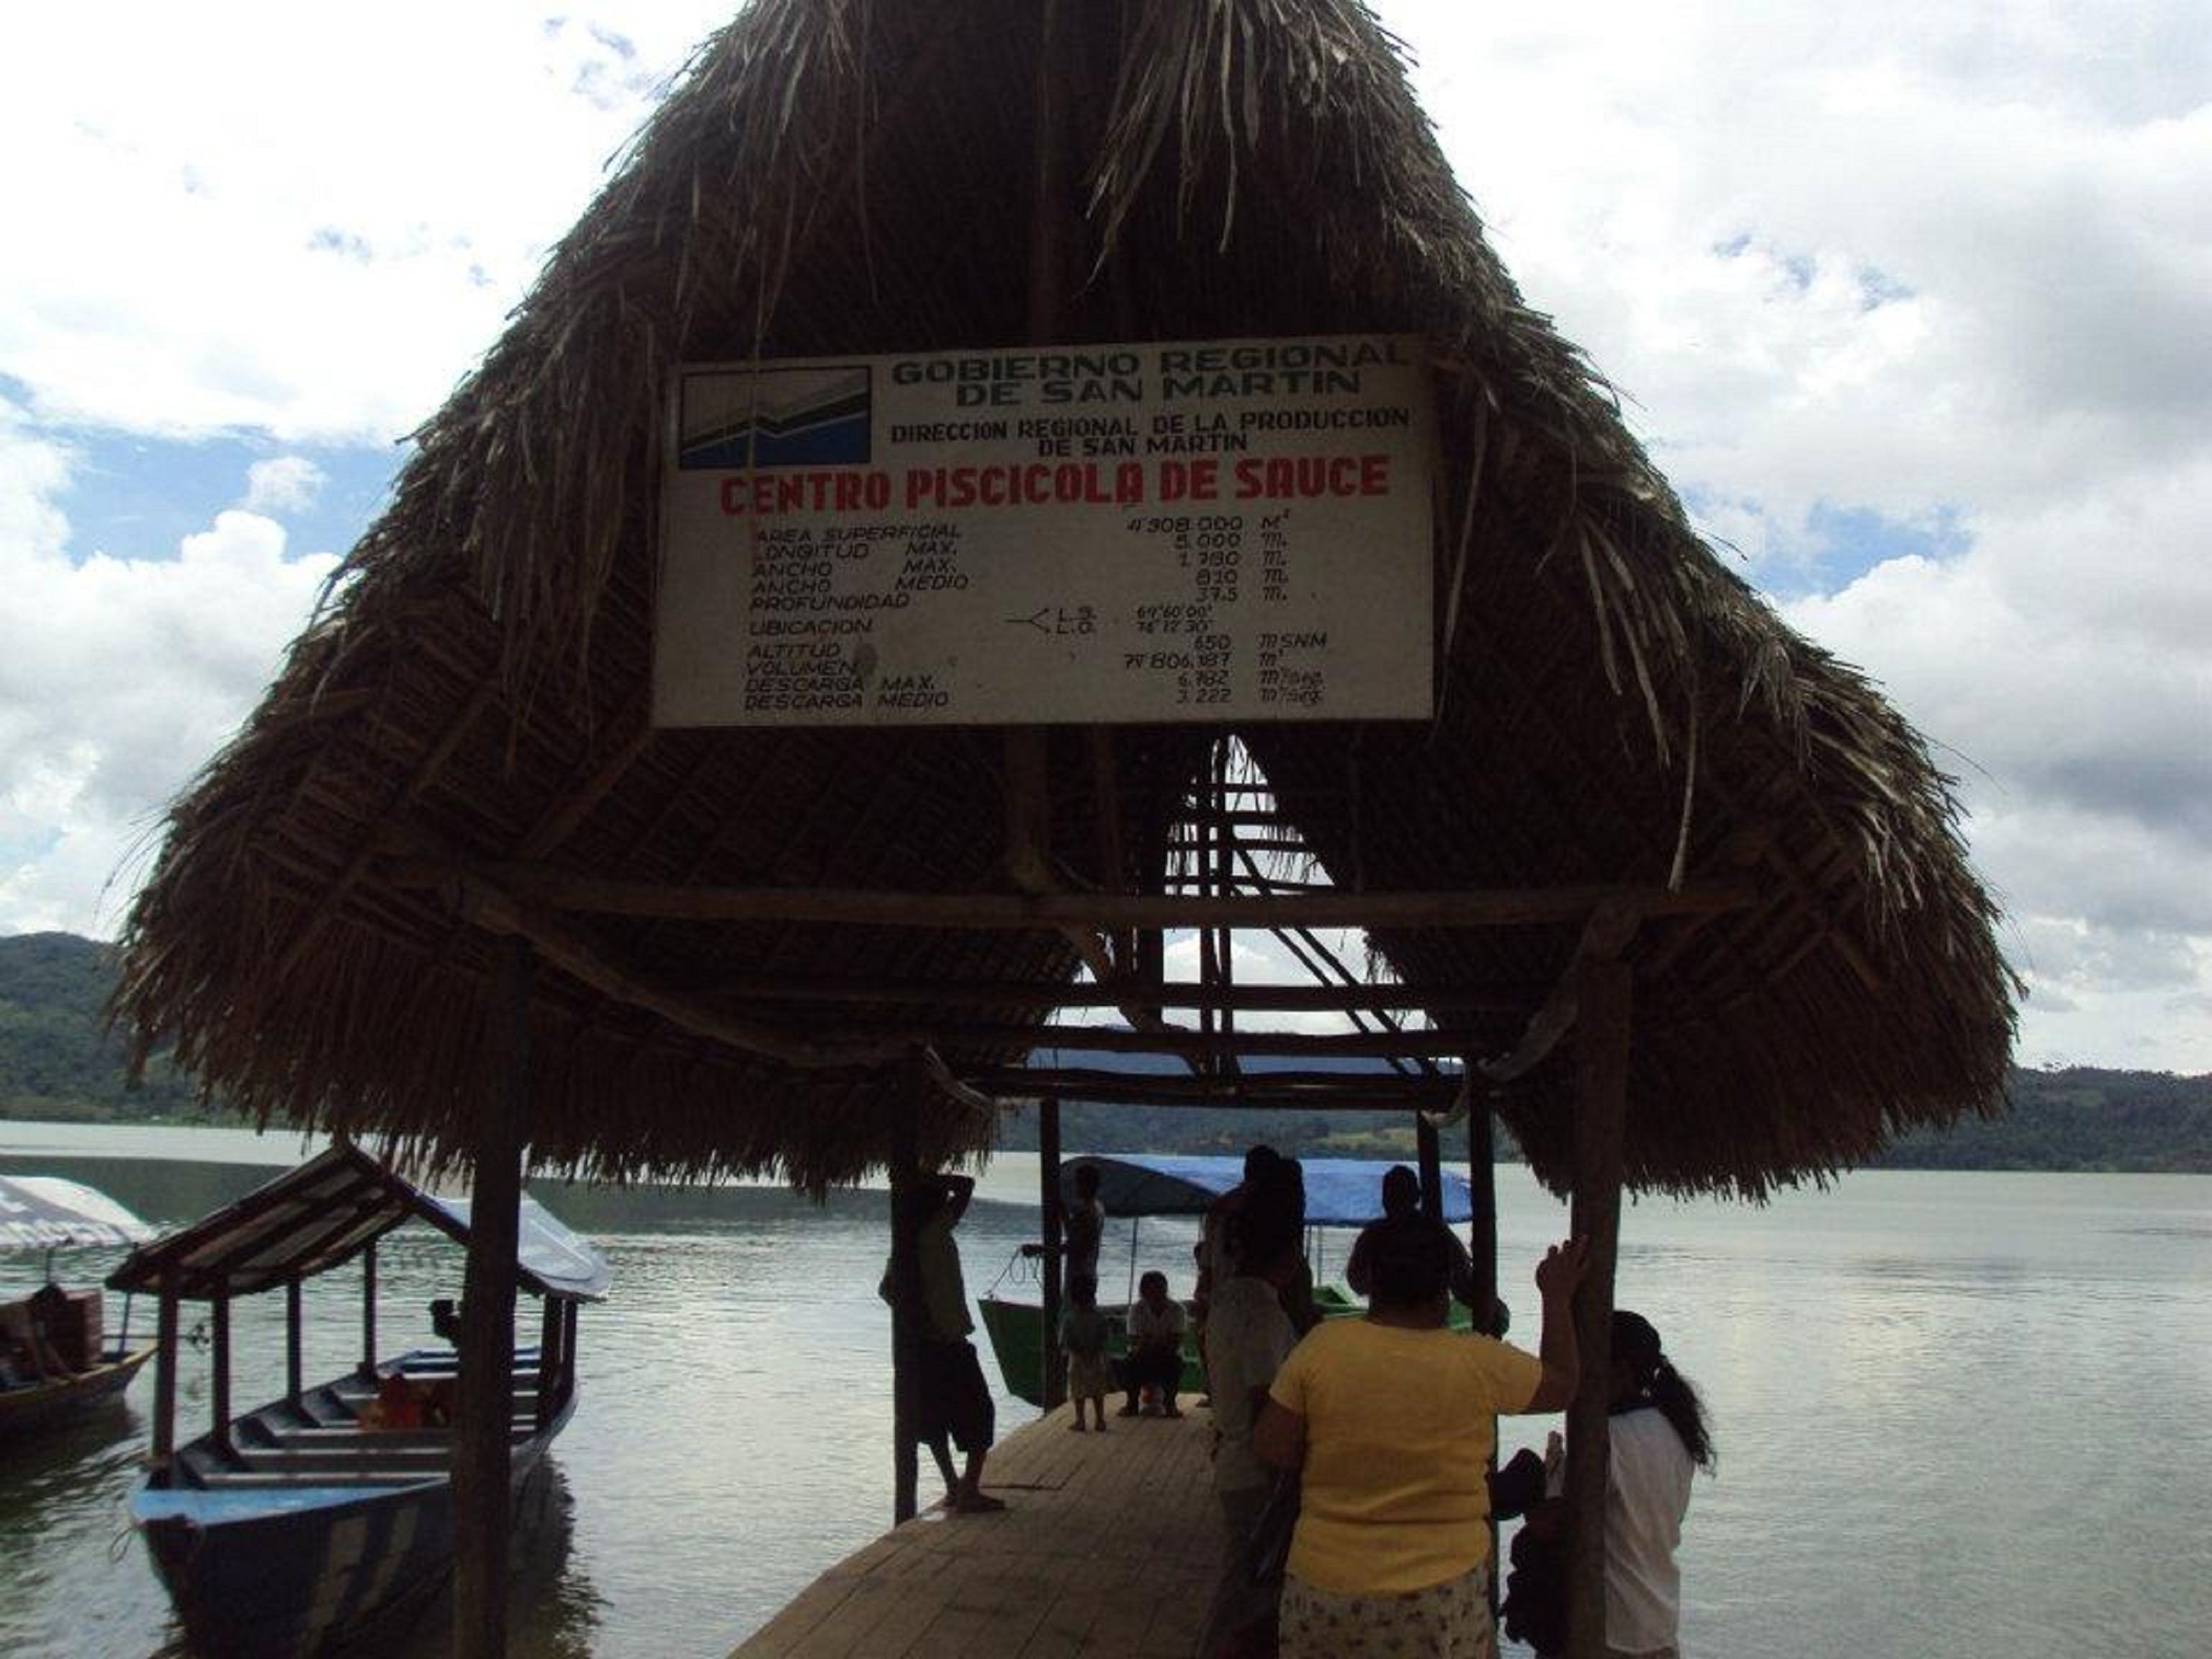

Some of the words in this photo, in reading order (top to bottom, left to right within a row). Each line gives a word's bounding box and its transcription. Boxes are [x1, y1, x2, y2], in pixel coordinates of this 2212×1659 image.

[891, 353, 1140, 385] GOBIERNO
[1161, 343, 1409, 374] REGIONAL
[957, 382, 1022, 406] DE
[1041, 379, 1143, 403] SAN
[1162, 369, 1360, 400] MARTIN
[891, 421, 1007, 443] DIRECCION
[1017, 416, 1138, 439] REGIONAL
[1154, 414, 1185, 433] DE
[1195, 413, 1227, 431] LA
[1241, 407, 1409, 431] PRODUCCION
[1038, 439, 1071, 457] DE
[1083, 437, 1135, 456] SAN
[1147, 433, 1248, 454] MARTIN
[721, 472, 891, 516] CENTRO
[907, 462, 1144, 509] PISCICOLA
[1159, 459, 1218, 502] DE
[1234, 454, 1390, 498] SAUCE
[757, 528, 811, 543] AREA
[824, 523, 961, 541] SUPERFICIAL
[756, 542, 869, 562] LONGITUD
[752, 561, 833, 577] ANCHO
[753, 579, 832, 595] ANCHO
[895, 575, 969, 591] MEDIO
[749, 593, 911, 611] PROFUNDIDAD
[749, 618, 873, 636] UBICACION
[747, 643, 840, 659] ALTITUD
[745, 676, 864, 693] DESCARGA
[745, 693, 863, 710] DESCARGA
[878, 691, 948, 708] MEDIO
